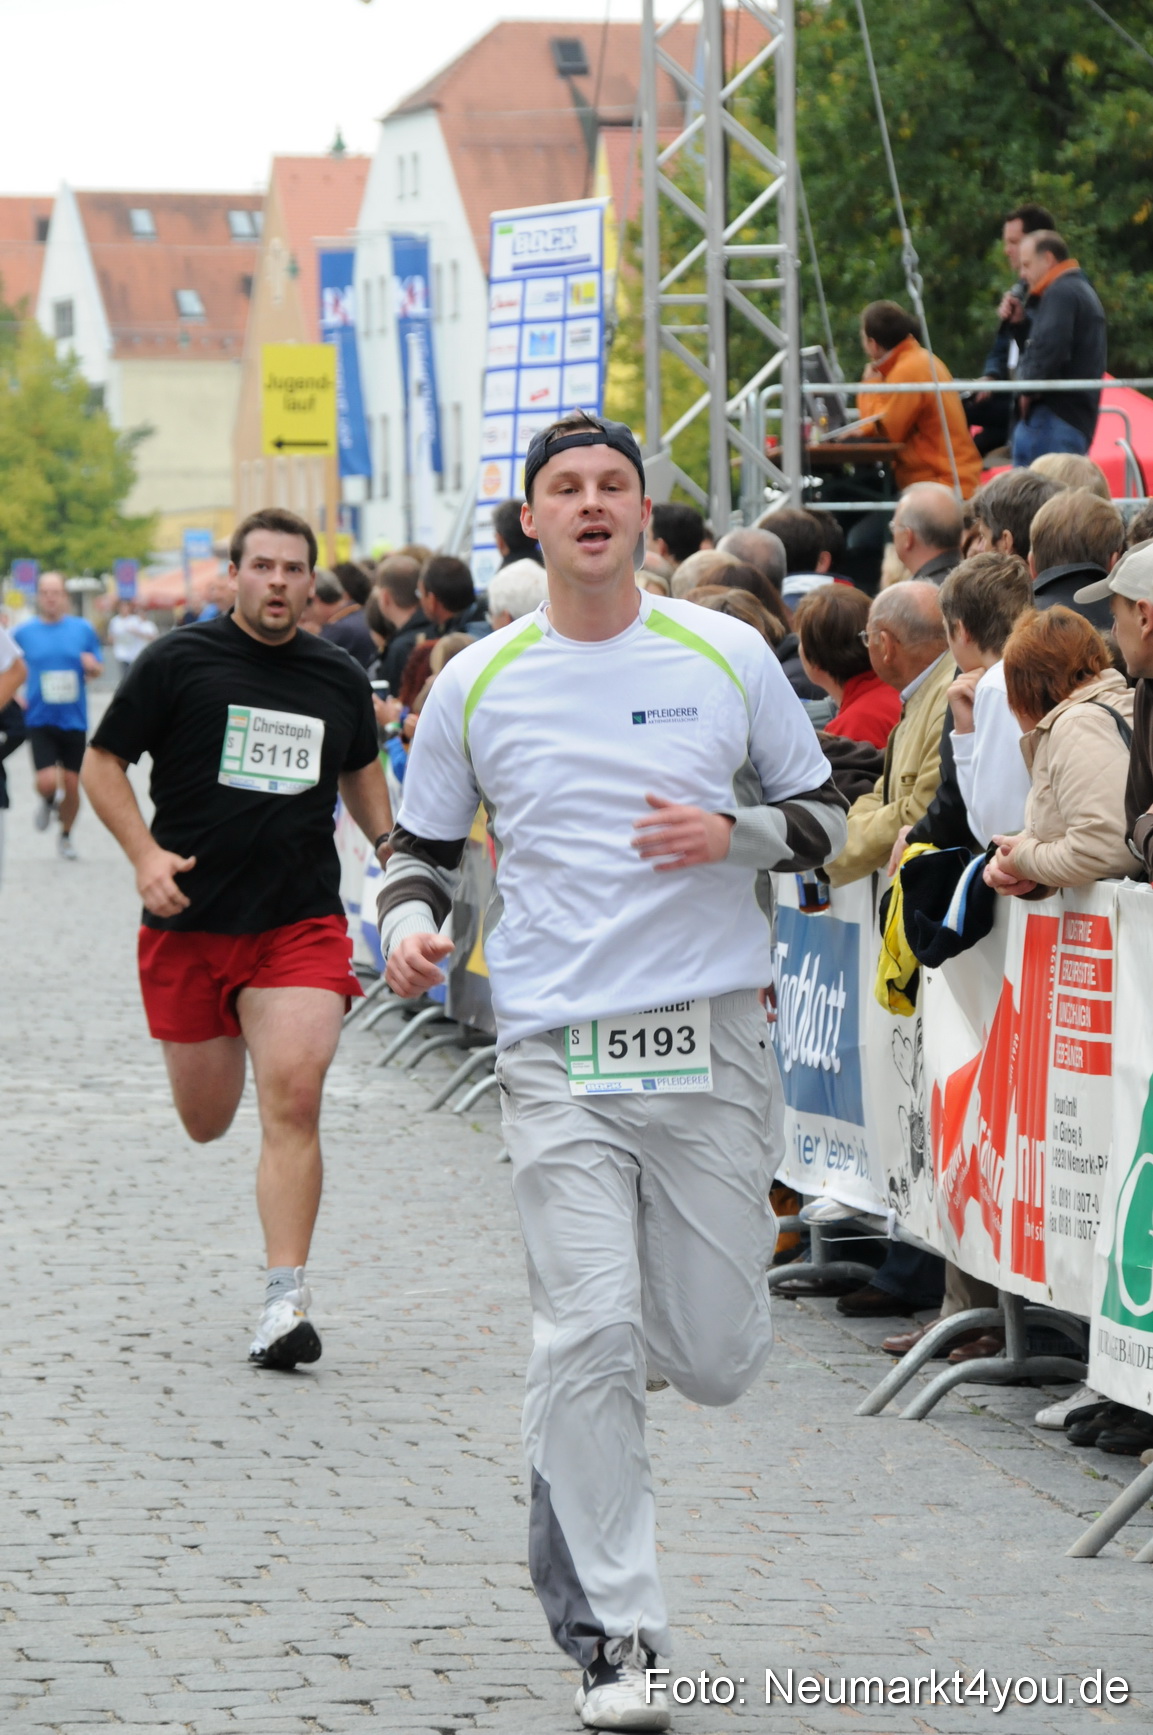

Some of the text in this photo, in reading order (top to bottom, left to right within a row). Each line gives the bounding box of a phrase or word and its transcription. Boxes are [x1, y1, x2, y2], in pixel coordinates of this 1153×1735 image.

[283, 393, 316, 412] lauf
[647, 707, 699, 718] PFLEIDERER
[252, 716, 312, 740] Christoph
[250, 742, 310, 770] 5118
[571, 1029, 580, 1045] S
[608, 1026, 696, 1059] 5193
[657, 1076, 710, 1086] PFLEIDERER
[793, 1124, 821, 1167] ier
